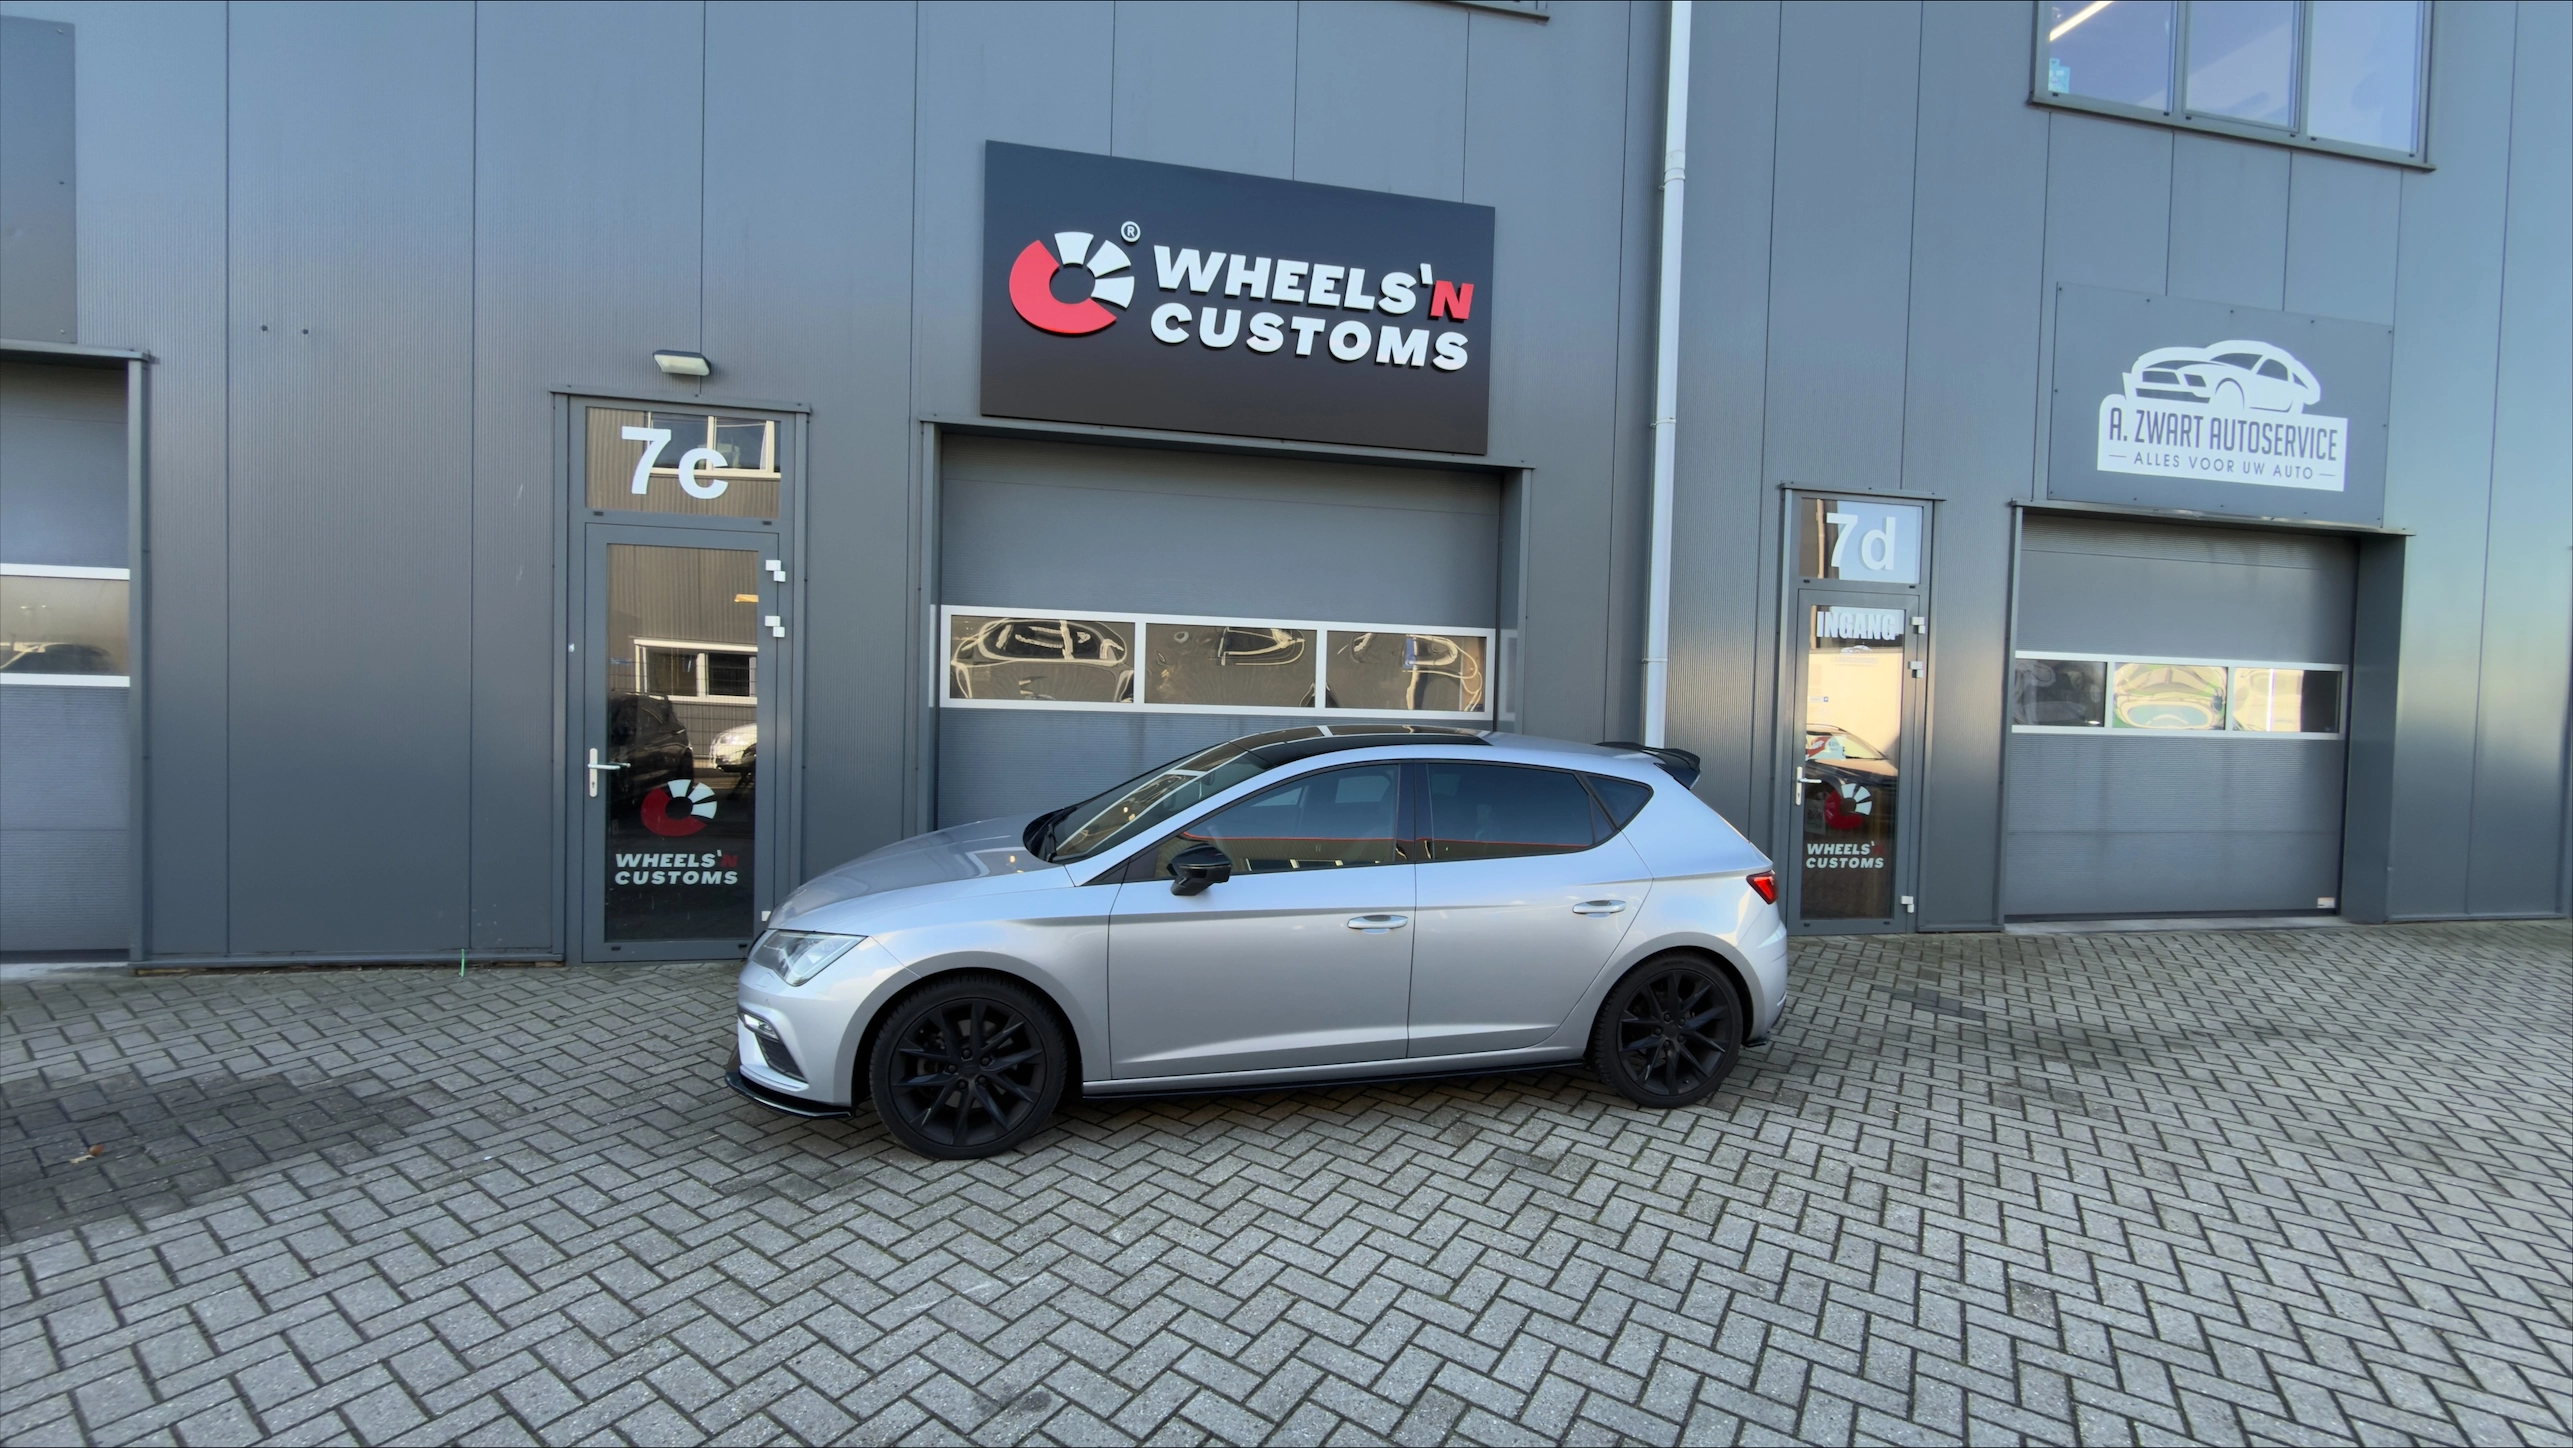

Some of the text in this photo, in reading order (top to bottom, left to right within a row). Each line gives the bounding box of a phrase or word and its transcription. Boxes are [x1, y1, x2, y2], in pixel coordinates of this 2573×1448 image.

[1150, 302, 1469, 371] CUSTOMS
[2109, 407, 2338, 461] A. ZWART AUTOSERVICE
[621, 426, 729, 500] 7c
[2134, 451, 2313, 480] ALLES VOOR UW AUTO
[1826, 512, 1896, 571] 7d
[1816, 611, 1896, 640] INGANG
[615, 871, 738, 885] CUSTOMS
[1806, 857, 1884, 869] CUSTOMS
